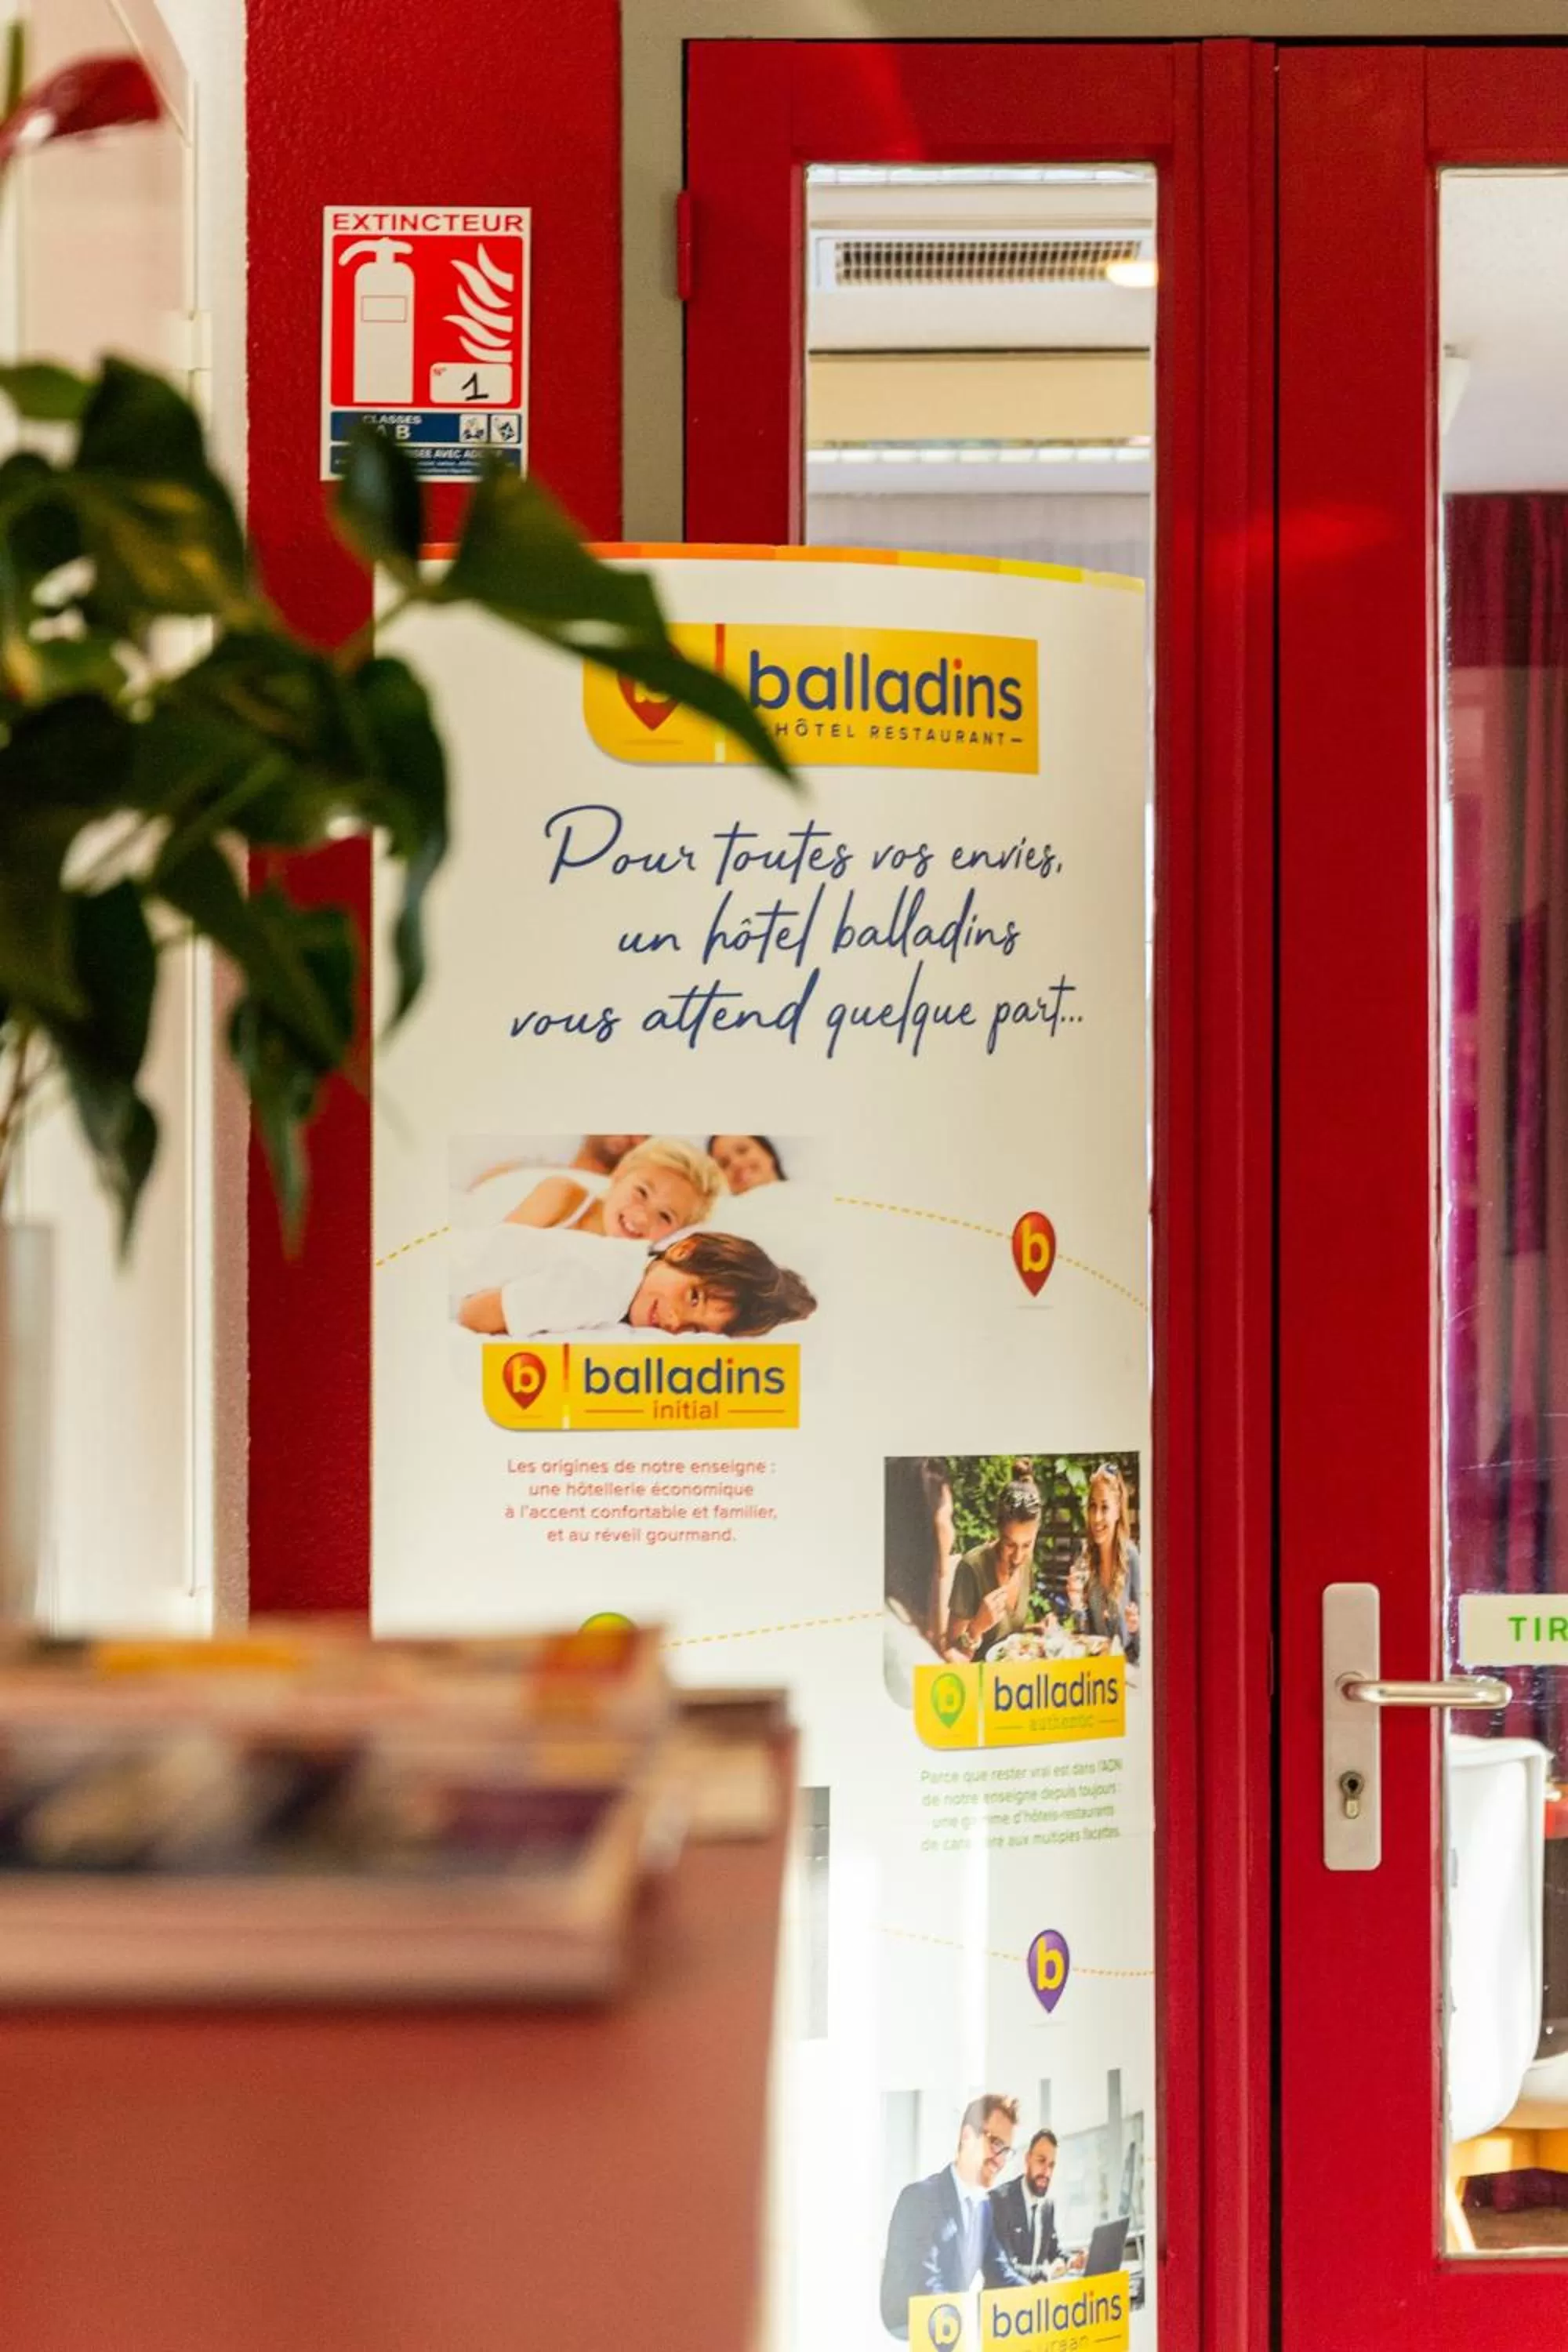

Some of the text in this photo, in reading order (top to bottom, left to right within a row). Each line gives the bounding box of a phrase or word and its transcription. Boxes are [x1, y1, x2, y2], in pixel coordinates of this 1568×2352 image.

[332, 212, 524, 233] EXTINCTEUR
[461, 372, 489, 401] 1
[395, 425, 412, 439] B
[749, 649, 1024, 721] balladins
[775, 719, 1006, 745] HÔTEL RESTAURANT
[544, 804, 1063, 885] Pour toutes vos envies,
[617, 882, 1022, 967] un hôtel balladins
[510, 960, 1084, 1058] vous attend quelque part...
[583, 1357, 786, 1395] balladins
[652, 1399, 720, 1420] initial
[506, 1459, 535, 1474] Les
[541, 1459, 608, 1477] origines
[614, 1459, 636, 1474] de
[641, 1459, 686, 1474] notre
[690, 1459, 766, 1477] enseigne
[528, 1481, 754, 1499] une hôtellerie économique
[505, 1504, 778, 1521] à l'accent confortable et familier,
[546, 1527, 736, 1546] et au réveil gourmand.
[1507, 1616, 1568, 1642] TIR
[993, 1671, 1120, 1712] balladins
[992, 2290, 1122, 2339] balladins
